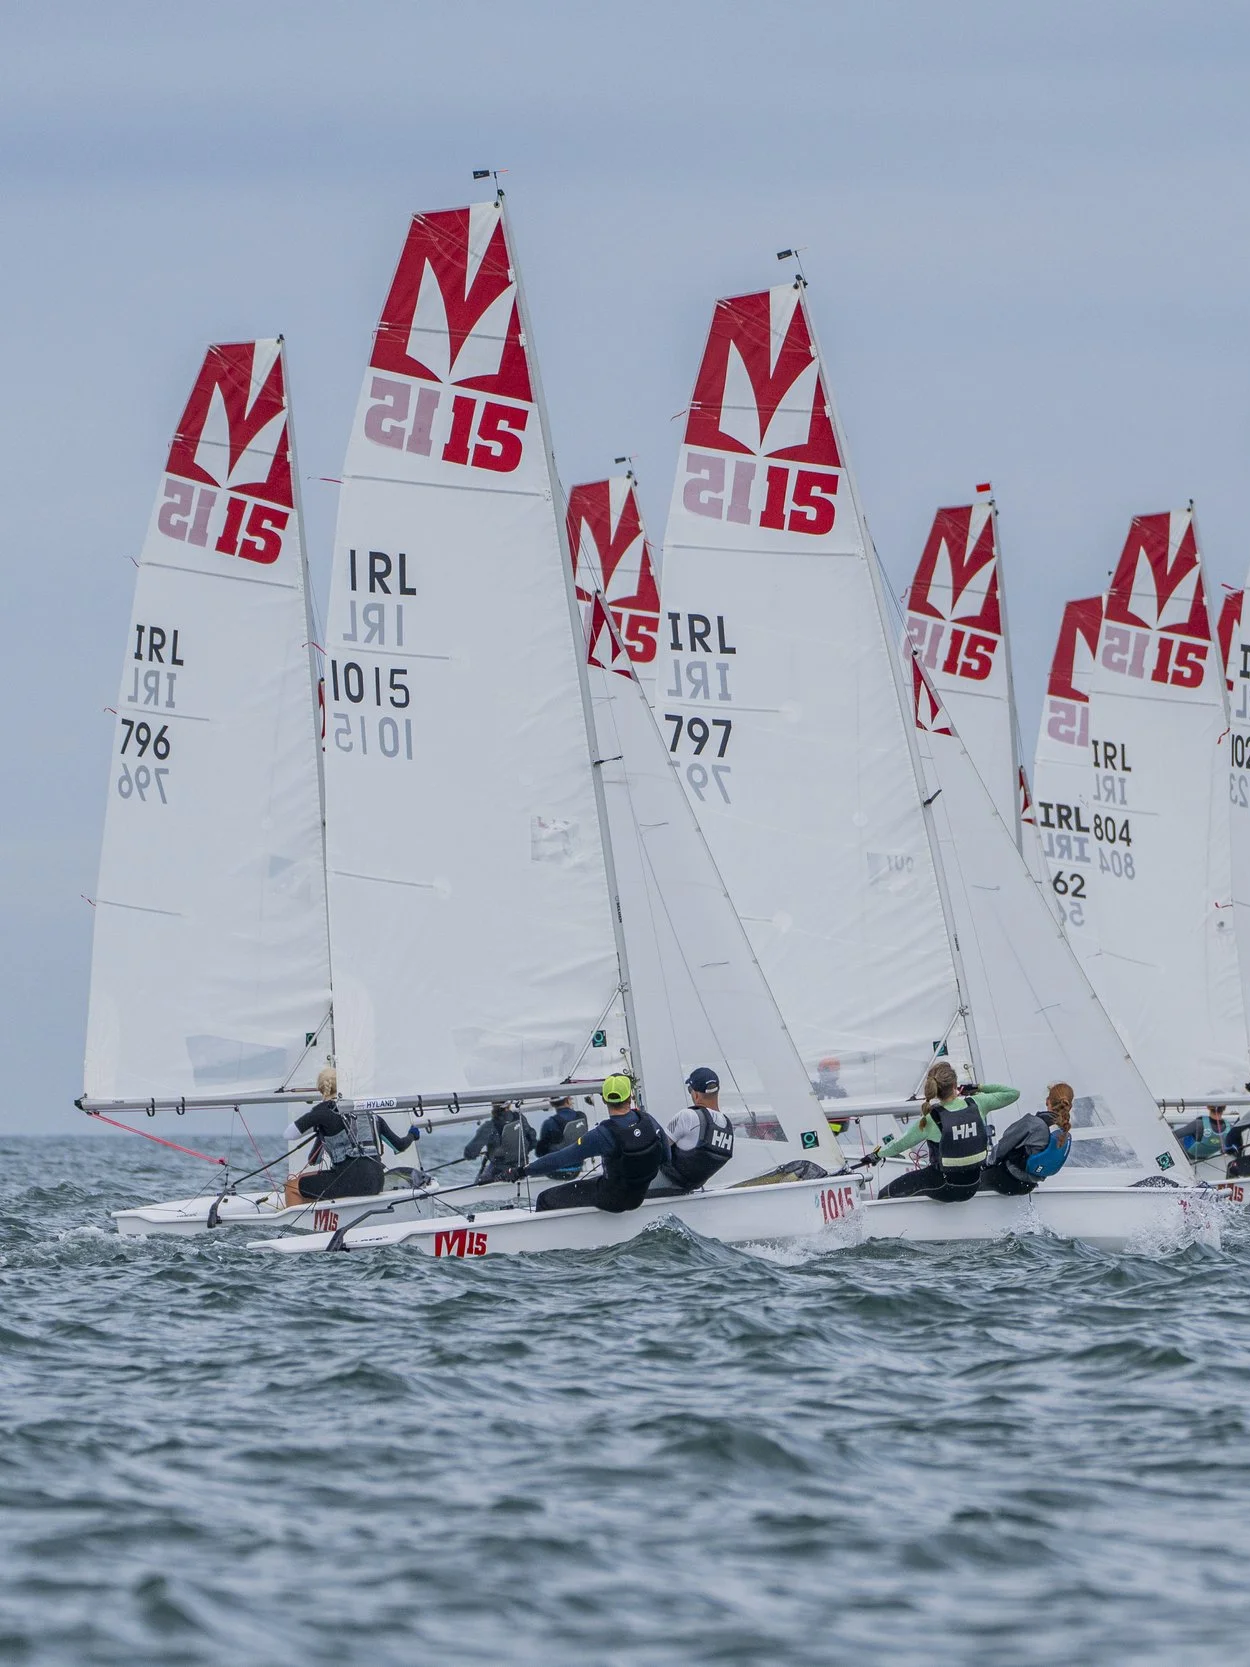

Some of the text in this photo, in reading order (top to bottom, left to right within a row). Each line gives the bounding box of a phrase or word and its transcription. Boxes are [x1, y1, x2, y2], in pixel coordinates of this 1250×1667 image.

[442, 395, 530, 473] 15
[759, 465, 840, 535] 15
[214, 496, 290, 564] 15
[350, 549, 417, 596] IRL
[134, 624, 184, 666] IRL
[668, 612, 736, 654] IRL
[942, 629, 998, 681] 15
[1151, 637, 1209, 689] 15
[331, 659, 410, 709] 1015
[120, 718, 171, 760] 796
[665, 714, 732, 758] 797
[1092, 740, 1132, 772] IRL
[1039, 802, 1090, 833] IRL
[1094, 813, 1132, 847] 804
[366, 1100, 395, 1109] HYLAND
[711, 1130, 733, 1150] HH
[952, 1122, 978, 1140] HH
[435, 1228, 487, 1258] M15
